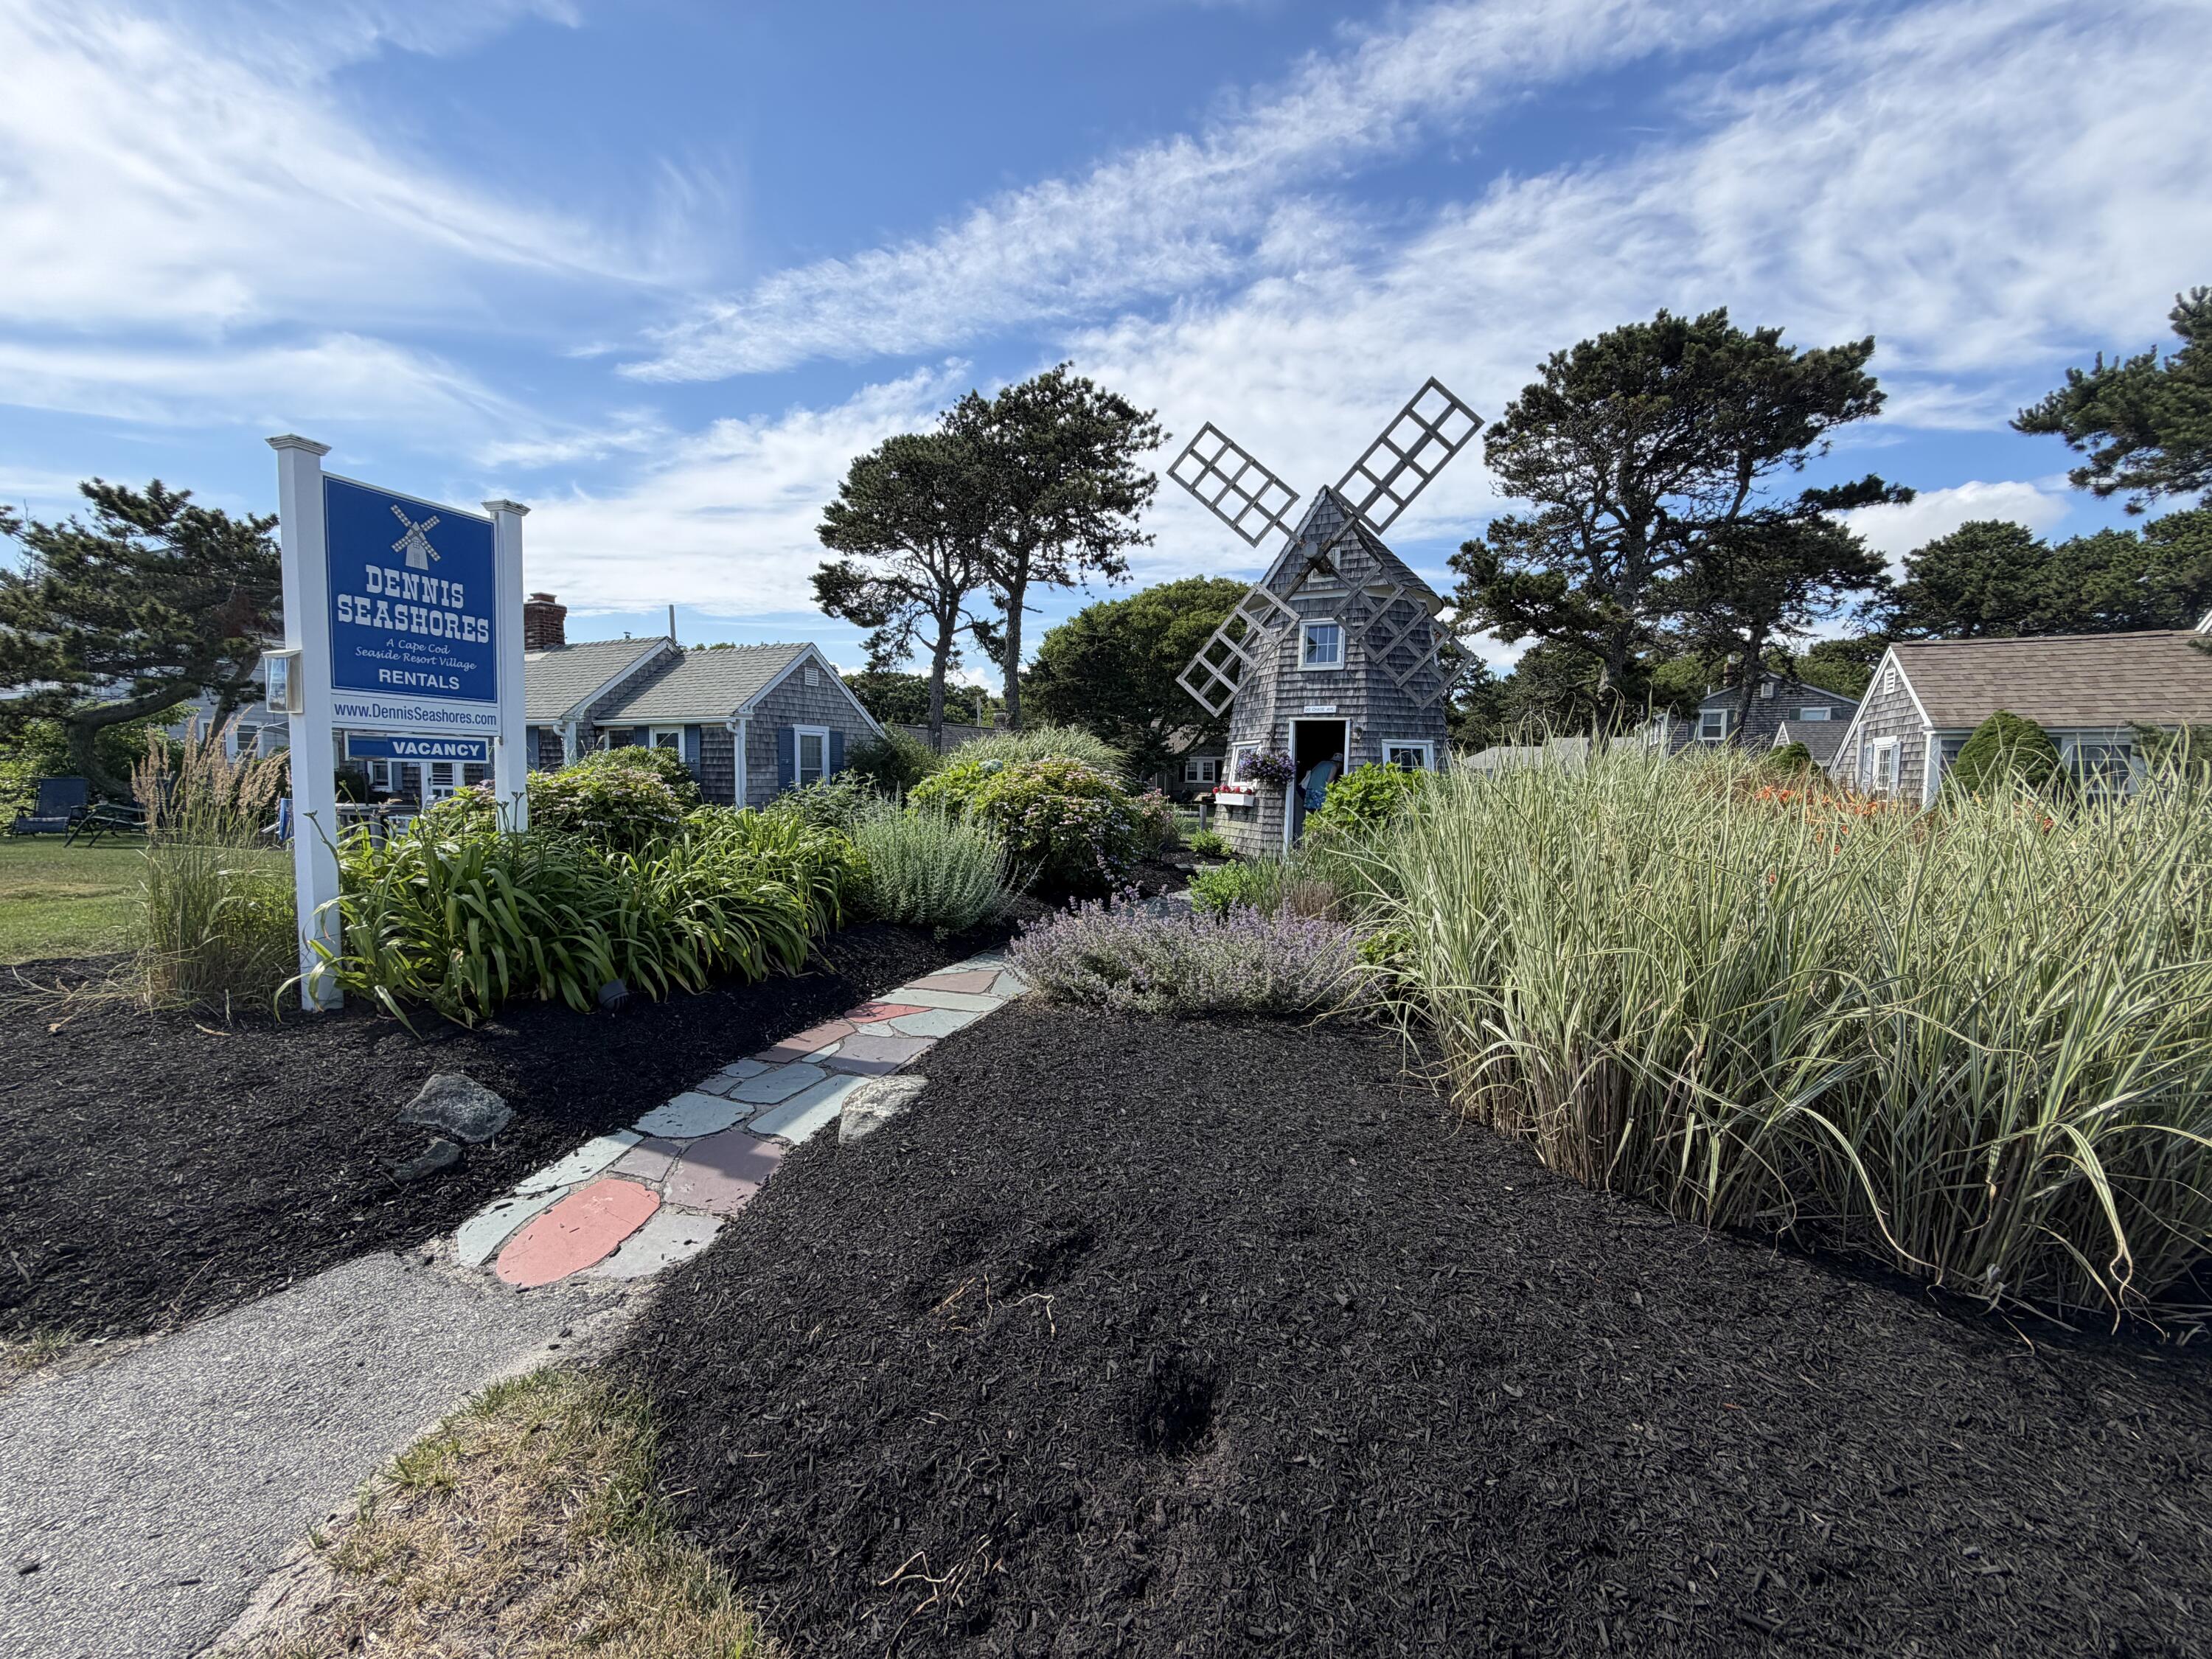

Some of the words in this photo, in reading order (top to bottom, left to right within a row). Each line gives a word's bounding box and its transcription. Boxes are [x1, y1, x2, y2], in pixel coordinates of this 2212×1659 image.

[366, 564, 464, 609] DENNIS
[338, 594, 489, 644] SEASHORES
[386, 638, 394, 647] A
[398, 639, 427, 653] Cape
[428, 644, 451, 655] Cod
[355, 646, 401, 661] Seaside
[403, 653, 438, 665] Resort
[439, 656, 477, 672] Village
[378, 669, 460, 690] RENTALS
[334, 703, 497, 726] www.DennisSeashores.com
[392, 741, 480, 757] VACANCY
